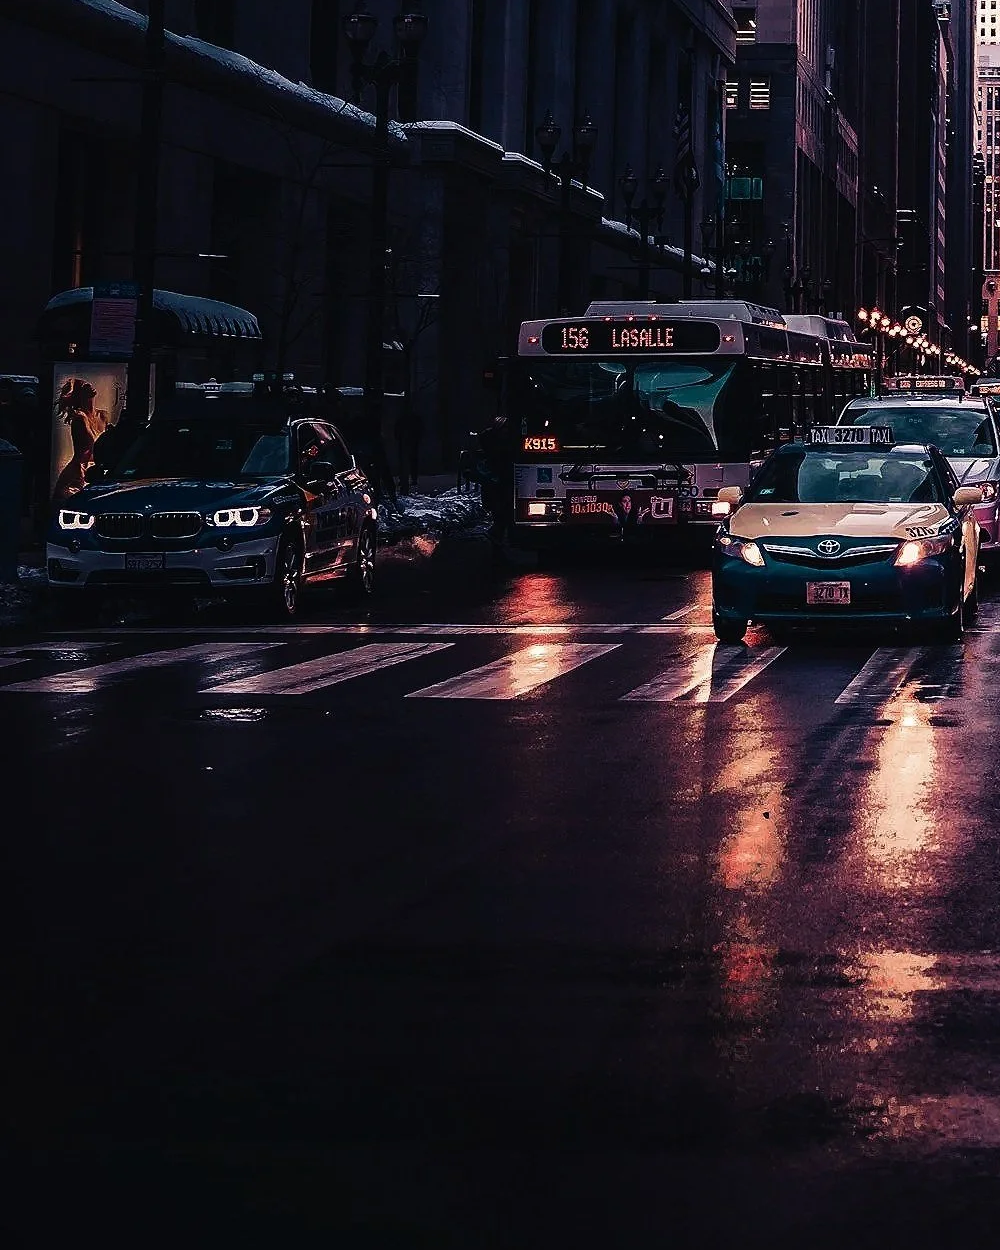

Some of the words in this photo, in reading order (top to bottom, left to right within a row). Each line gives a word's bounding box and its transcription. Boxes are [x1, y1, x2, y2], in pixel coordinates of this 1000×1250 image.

[561, 327, 589, 349] 156
[612, 328, 674, 348] LASALLE
[811, 429, 830, 443] TAXI
[835, 428, 864, 443] 3270
[871, 428, 891, 443] TAXI
[524, 437, 556, 450] K915
[813, 586, 834, 599] 3270
